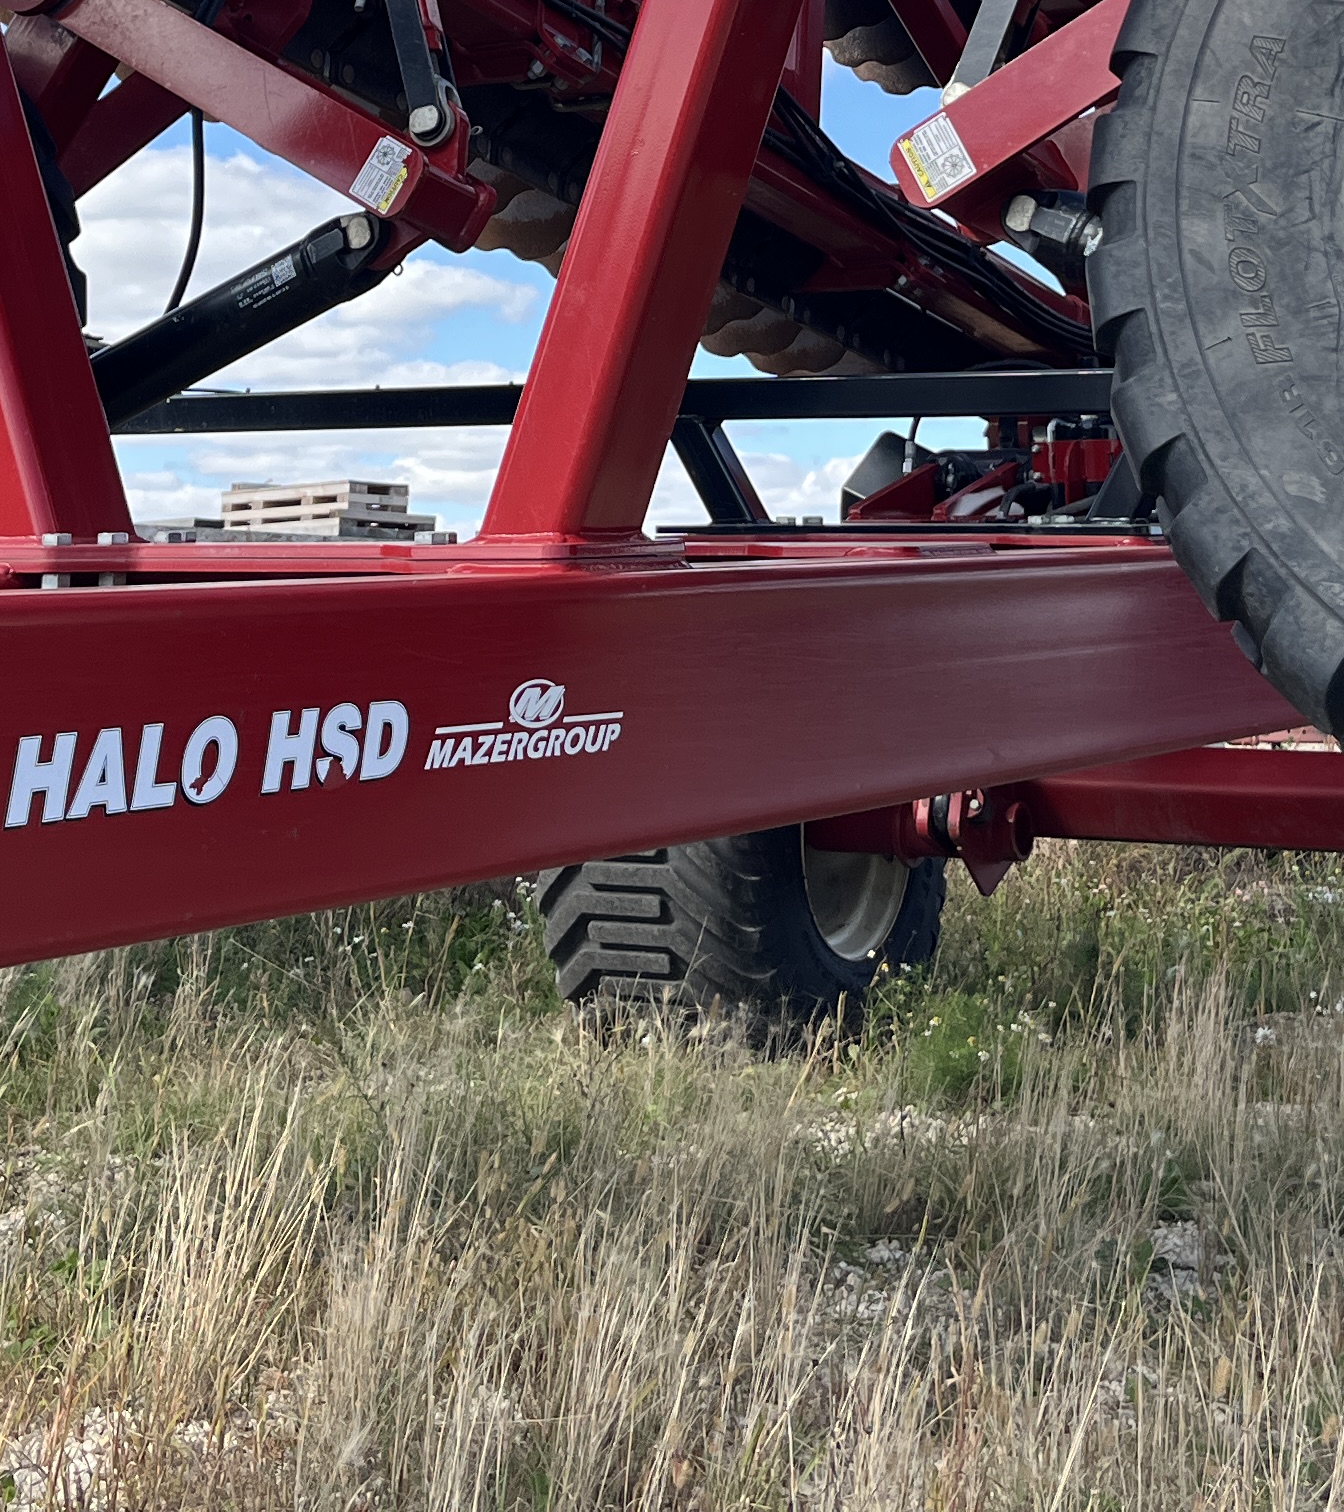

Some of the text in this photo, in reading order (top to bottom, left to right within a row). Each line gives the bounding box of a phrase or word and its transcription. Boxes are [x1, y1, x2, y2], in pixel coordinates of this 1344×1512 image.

[4, 714, 238, 828] HALO
[261, 700, 409, 793] HSD
[424, 722, 622, 770] MAZERGROUP
